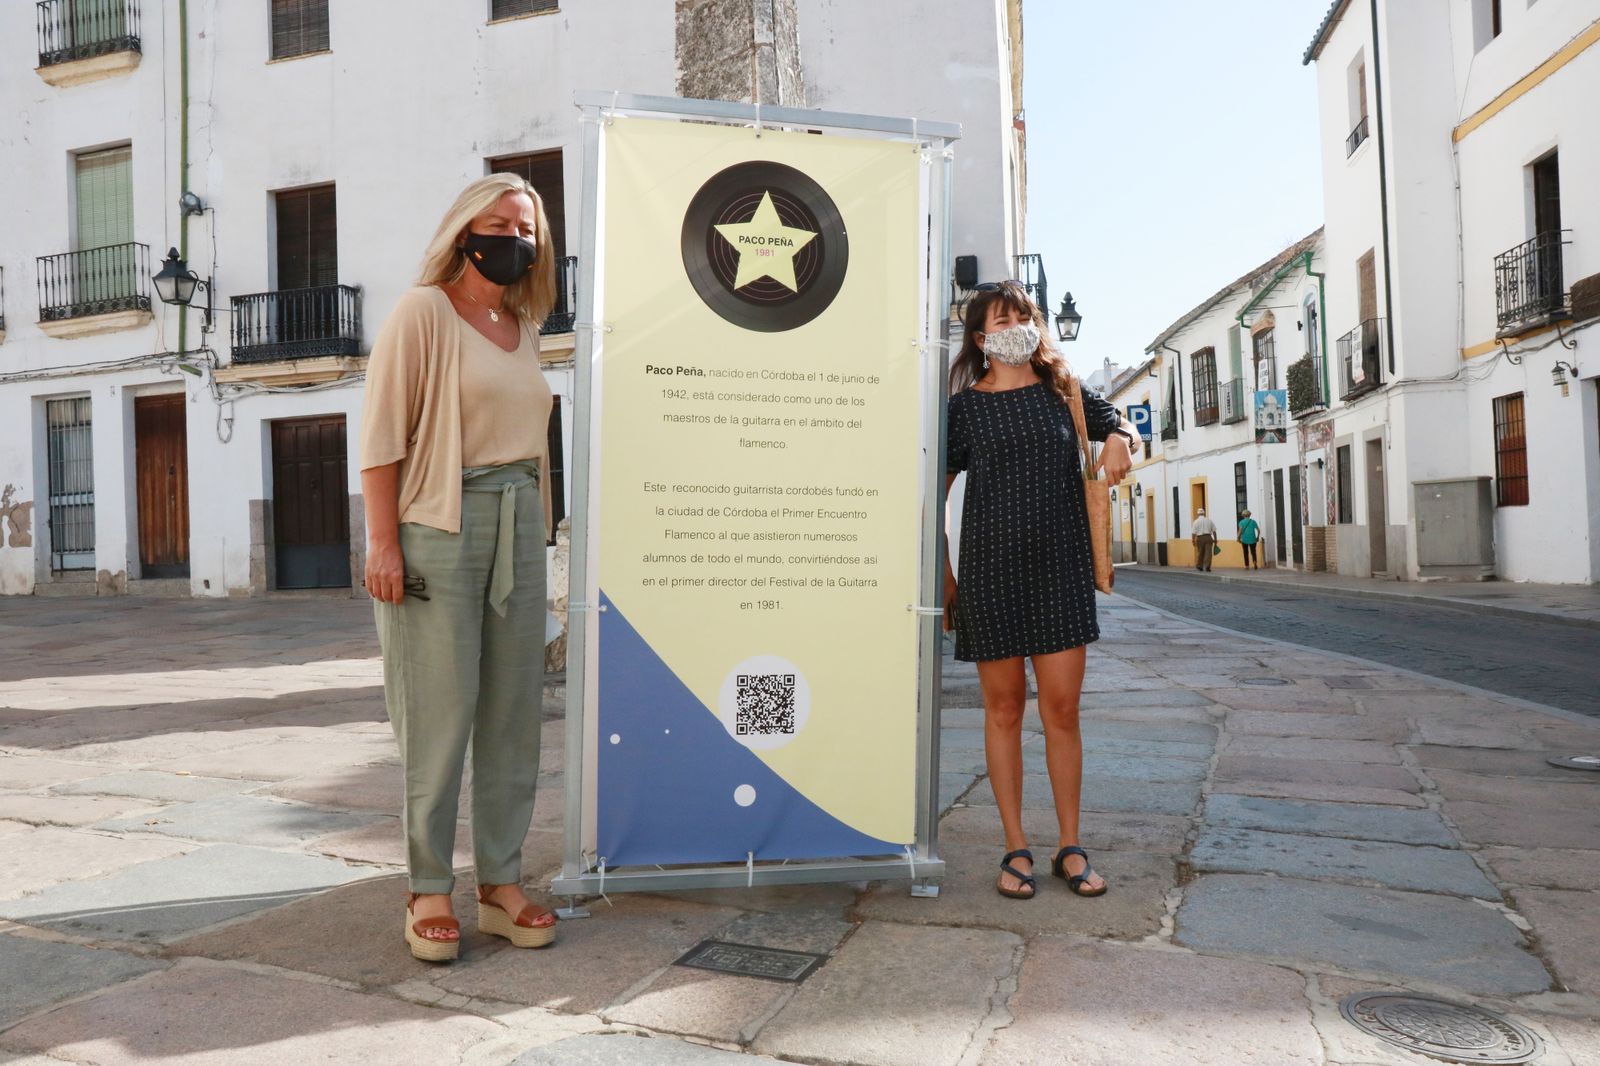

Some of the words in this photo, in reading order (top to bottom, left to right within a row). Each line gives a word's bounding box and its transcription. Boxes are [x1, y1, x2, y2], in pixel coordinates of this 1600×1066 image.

[739, 236, 765, 245] PACO
[768, 237, 793, 247] PEÑA
[646, 364, 673, 375] Paco
[676, 365, 706, 378] Peña,
[709, 368, 744, 378] nacido
[746, 370, 758, 379] en
[761, 369, 804, 381] Córdoba
[808, 372, 816, 382] el
[818, 372, 824, 382] 1
[827, 372, 839, 382] de
[841, 372, 864, 385] junio
[868, 374, 880, 384] de
[662, 389, 689, 401] 1942,
[692, 390, 714, 400] está
[718, 391, 780, 403] considerado
[784, 394, 811, 404] como
[814, 395, 832, 405] uno
[836, 395, 848, 406] de
[852, 396, 864, 406] los
[663, 413, 710, 424] maestros
[714, 414, 727, 424] de
[730, 414, 738, 424] la
[742, 415, 780, 428] guitarra
[784, 418, 796, 426] en
[799, 417, 807, 427] el
[811, 417, 844, 428] ámbito
[847, 418, 862, 428] del
[1130, 407, 1149, 425] P
[739, 438, 788, 449] flamenco.
[644, 482, 666, 492] Este
[672, 483, 730, 494] reconocido
[734, 484, 783, 496] guitarrista
[786, 485, 832, 496] cordobés
[836, 486, 863, 496] fundó
[866, 488, 878, 496] en
[656, 506, 664, 516] la
[668, 506, 703, 517] ciudad
[707, 507, 720, 517] de
[723, 506, 767, 518] Córdoba
[771, 508, 779, 518] el
[782, 508, 814, 519] Primer
[817, 509, 867, 520] Encuentro
[665, 530, 715, 540] Flamenco
[718, 530, 727, 540] al
[731, 532, 750, 543] que
[753, 531, 800, 541] asistieron
[804, 532, 857, 542] numerosos
[643, 553, 686, 564] alumnos
[690, 554, 703, 563] de
[708, 554, 730, 563] todo
[734, 554, 742, 564] el
[746, 554, 784, 565] mundo,
[788, 554, 860, 564] convirtiéndose
[642, 577, 655, 586] en
[659, 576, 668, 586] el
[672, 577, 704, 588] primer
[708, 576, 747, 586] director
[750, 577, 766, 587] del
[770, 577, 807, 587] Festival
[810, 577, 823, 587] de
[826, 578, 835, 587] la
[838, 577, 878, 588] Guitarra
[740, 601, 752, 610] en
[757, 600, 783, 610] 1981.
